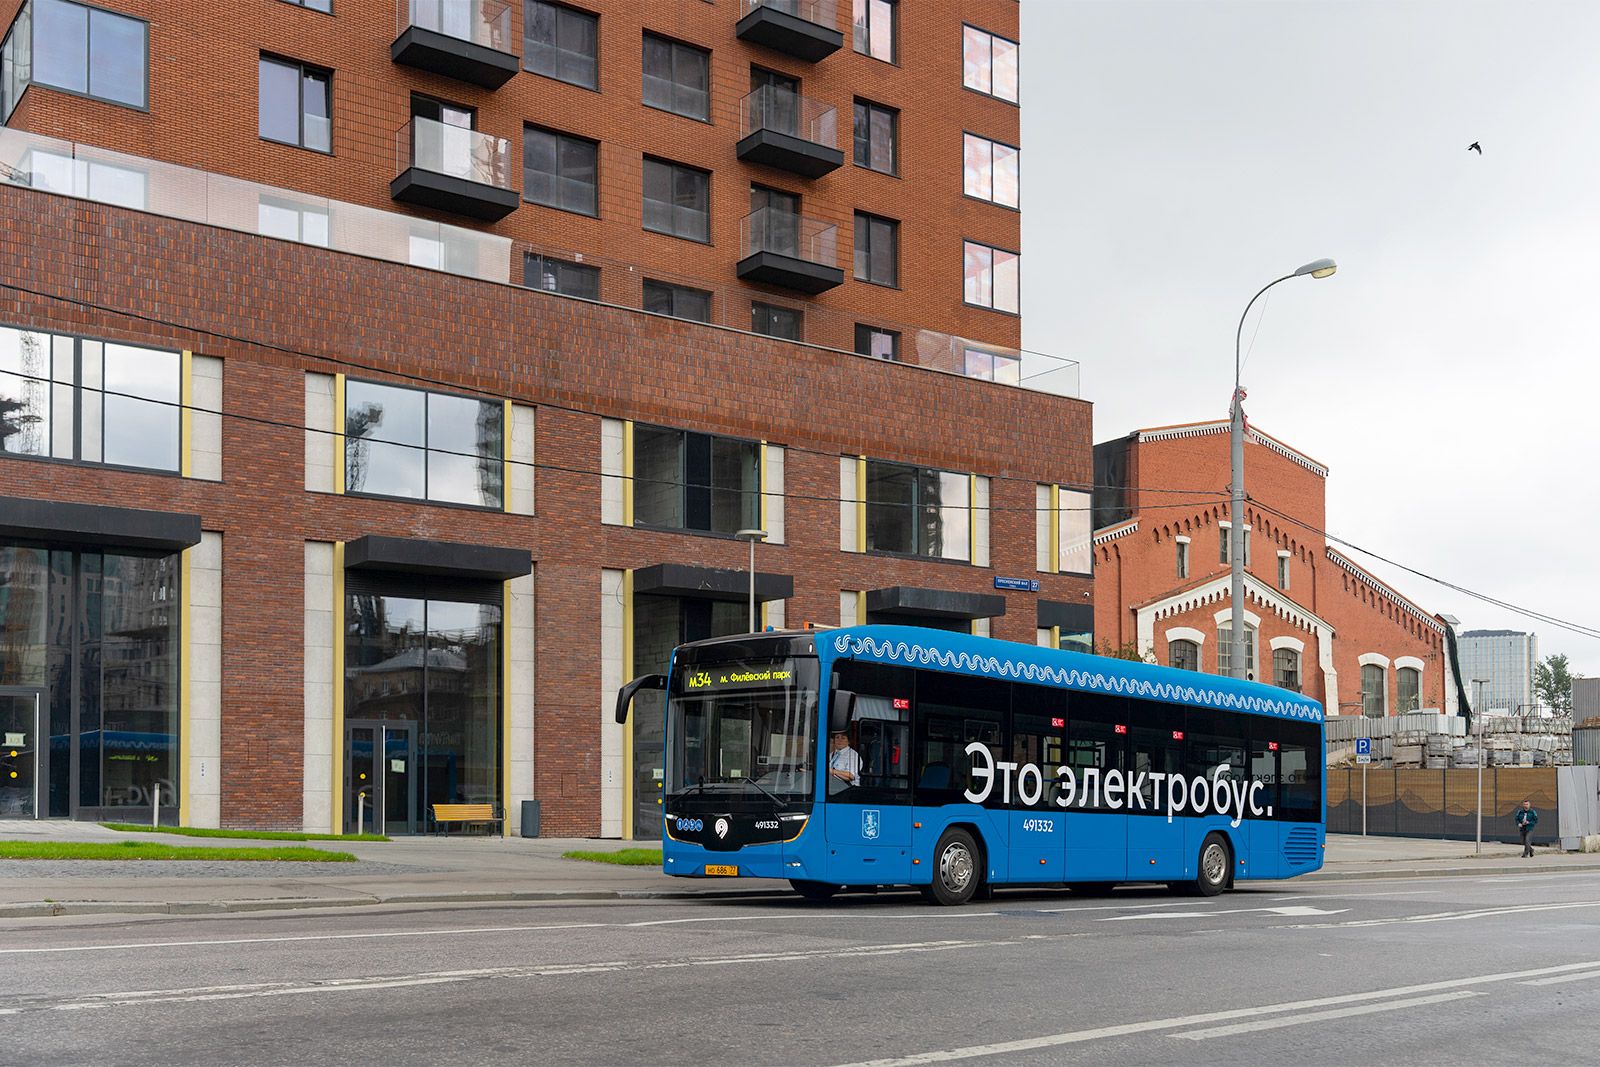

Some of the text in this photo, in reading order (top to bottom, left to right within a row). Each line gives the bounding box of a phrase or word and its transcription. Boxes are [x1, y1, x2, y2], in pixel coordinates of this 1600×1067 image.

[730, 671, 771, 683] Филёвский
[772, 670, 792, 681] парк
[1359, 740, 1368, 753] P
[963, 741, 1273, 828] Это электробус.
[755, 820, 779, 829] 491332
[1023, 818, 1054, 832] 491332
[717, 866, 728, 875] 686
